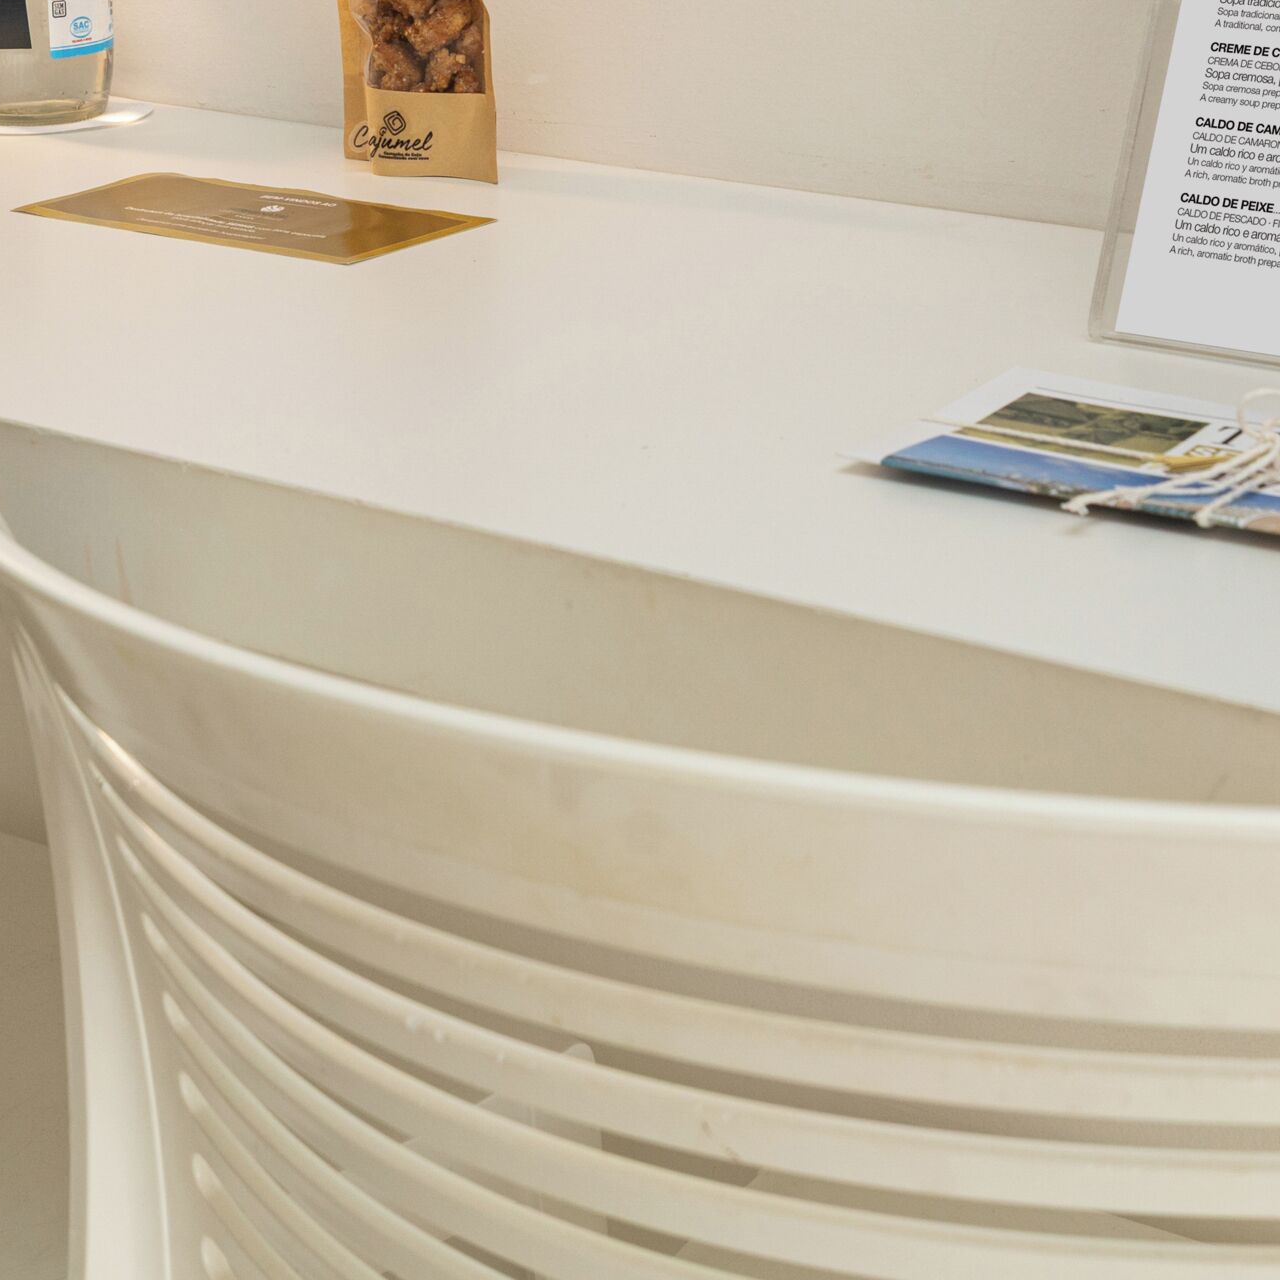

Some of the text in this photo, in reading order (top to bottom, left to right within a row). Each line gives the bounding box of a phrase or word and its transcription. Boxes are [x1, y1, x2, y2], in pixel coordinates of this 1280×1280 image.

[73, 20, 90, 30] SAC
[1210, 41, 1253, 56] CREME
[1252, 45, 1271, 57] DE
[1195, 116, 1236, 131] CALDO
[1236, 121, 1254, 133] DE
[353, 125, 434, 158] Cajumel
[1180, 192, 1221, 207] CALDO
[1221, 197, 1239, 210] DE
[1240, 199, 1275, 214] PEIXE
